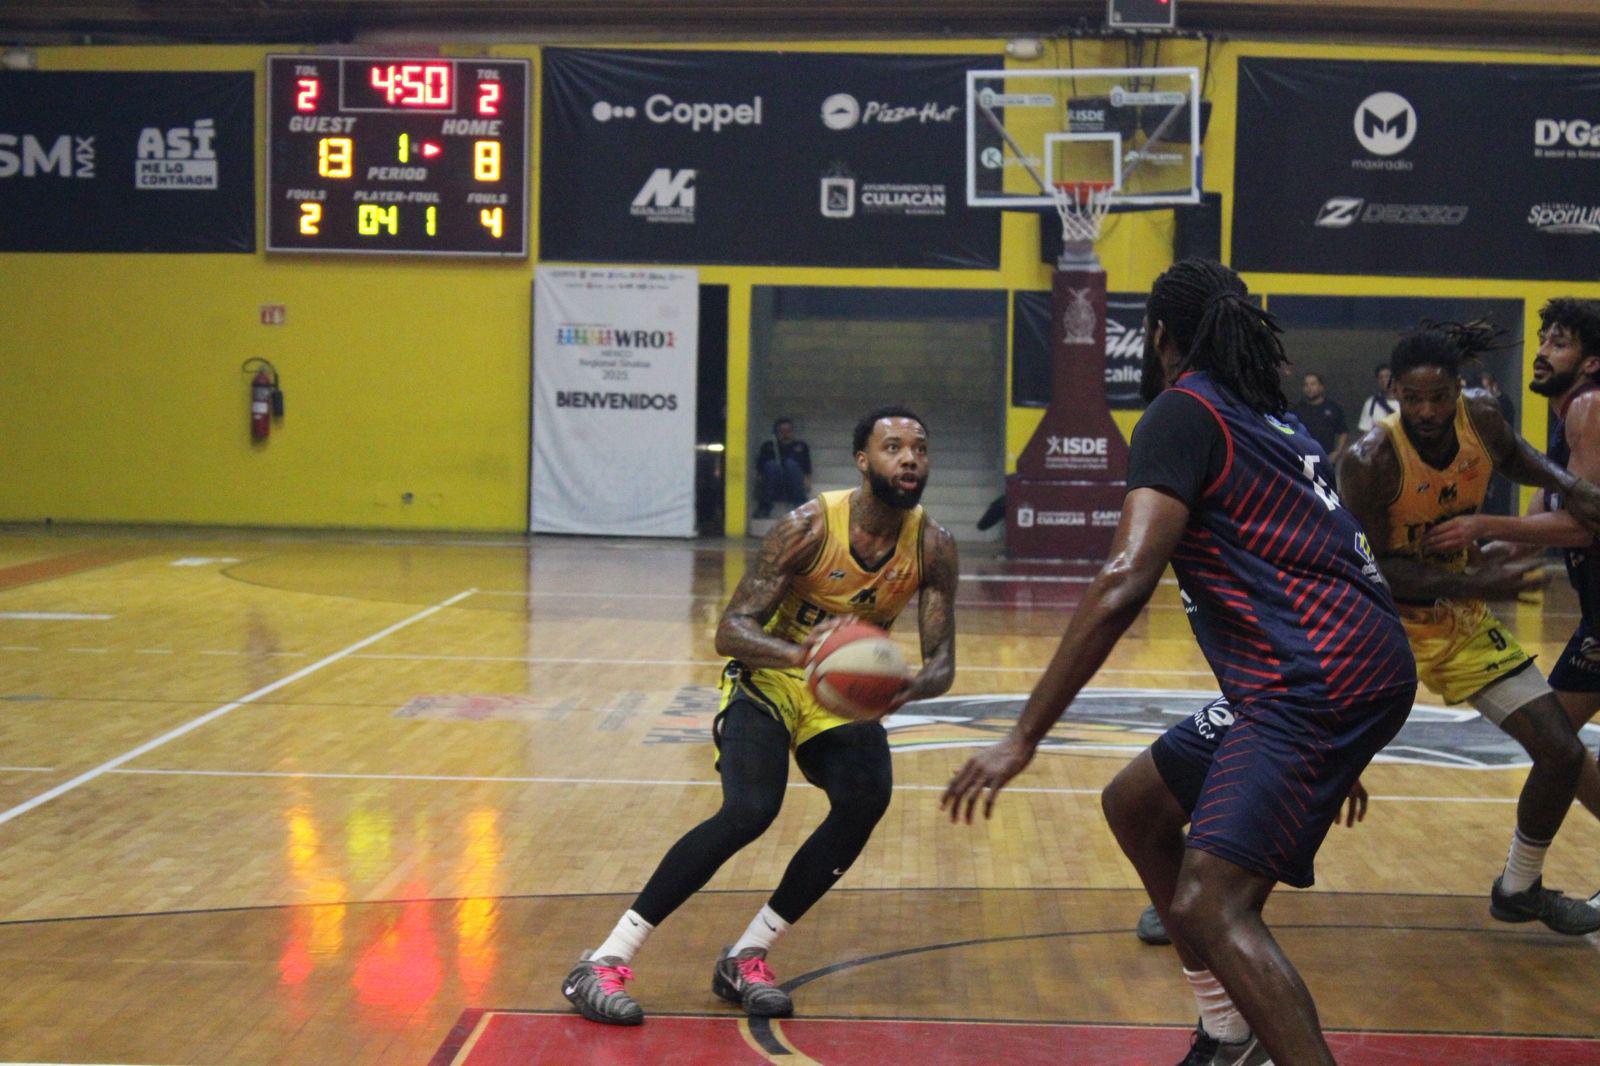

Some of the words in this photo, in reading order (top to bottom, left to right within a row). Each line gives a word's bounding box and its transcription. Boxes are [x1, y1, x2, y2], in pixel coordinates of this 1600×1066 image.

[297, 79, 319, 112] 2
[371, 65, 450, 105] 4:50
[478, 83, 501, 115] 2
[862, 101, 916, 124] Pizza
[917, 102, 959, 124] Hut
[289, 116, 357, 133] GUEST
[645, 94, 762, 132] Coppel
[137, 118, 216, 160] ASÍ
[441, 119, 503, 136] HOME
[319, 138, 353, 179] 13
[399, 133, 409, 163] 1
[474, 141, 501, 182] 8
[141, 162, 160, 174] ME
[164, 162, 184, 174] LO
[141, 175, 214, 186] CONTARON
[367, 166, 428, 181] PERIOD
[287, 189, 327, 200] FOULS
[467, 193, 508, 204] FOULS
[300, 203, 321, 235] 2
[358, 204, 398, 236] 04
[426, 206, 436, 236] 1
[481, 207, 503, 239] 4
[556, 390, 678, 411] BIENVENIDOS
[1062, 437, 1108, 455] ISDE
[1488, 628, 1507, 652] 9
